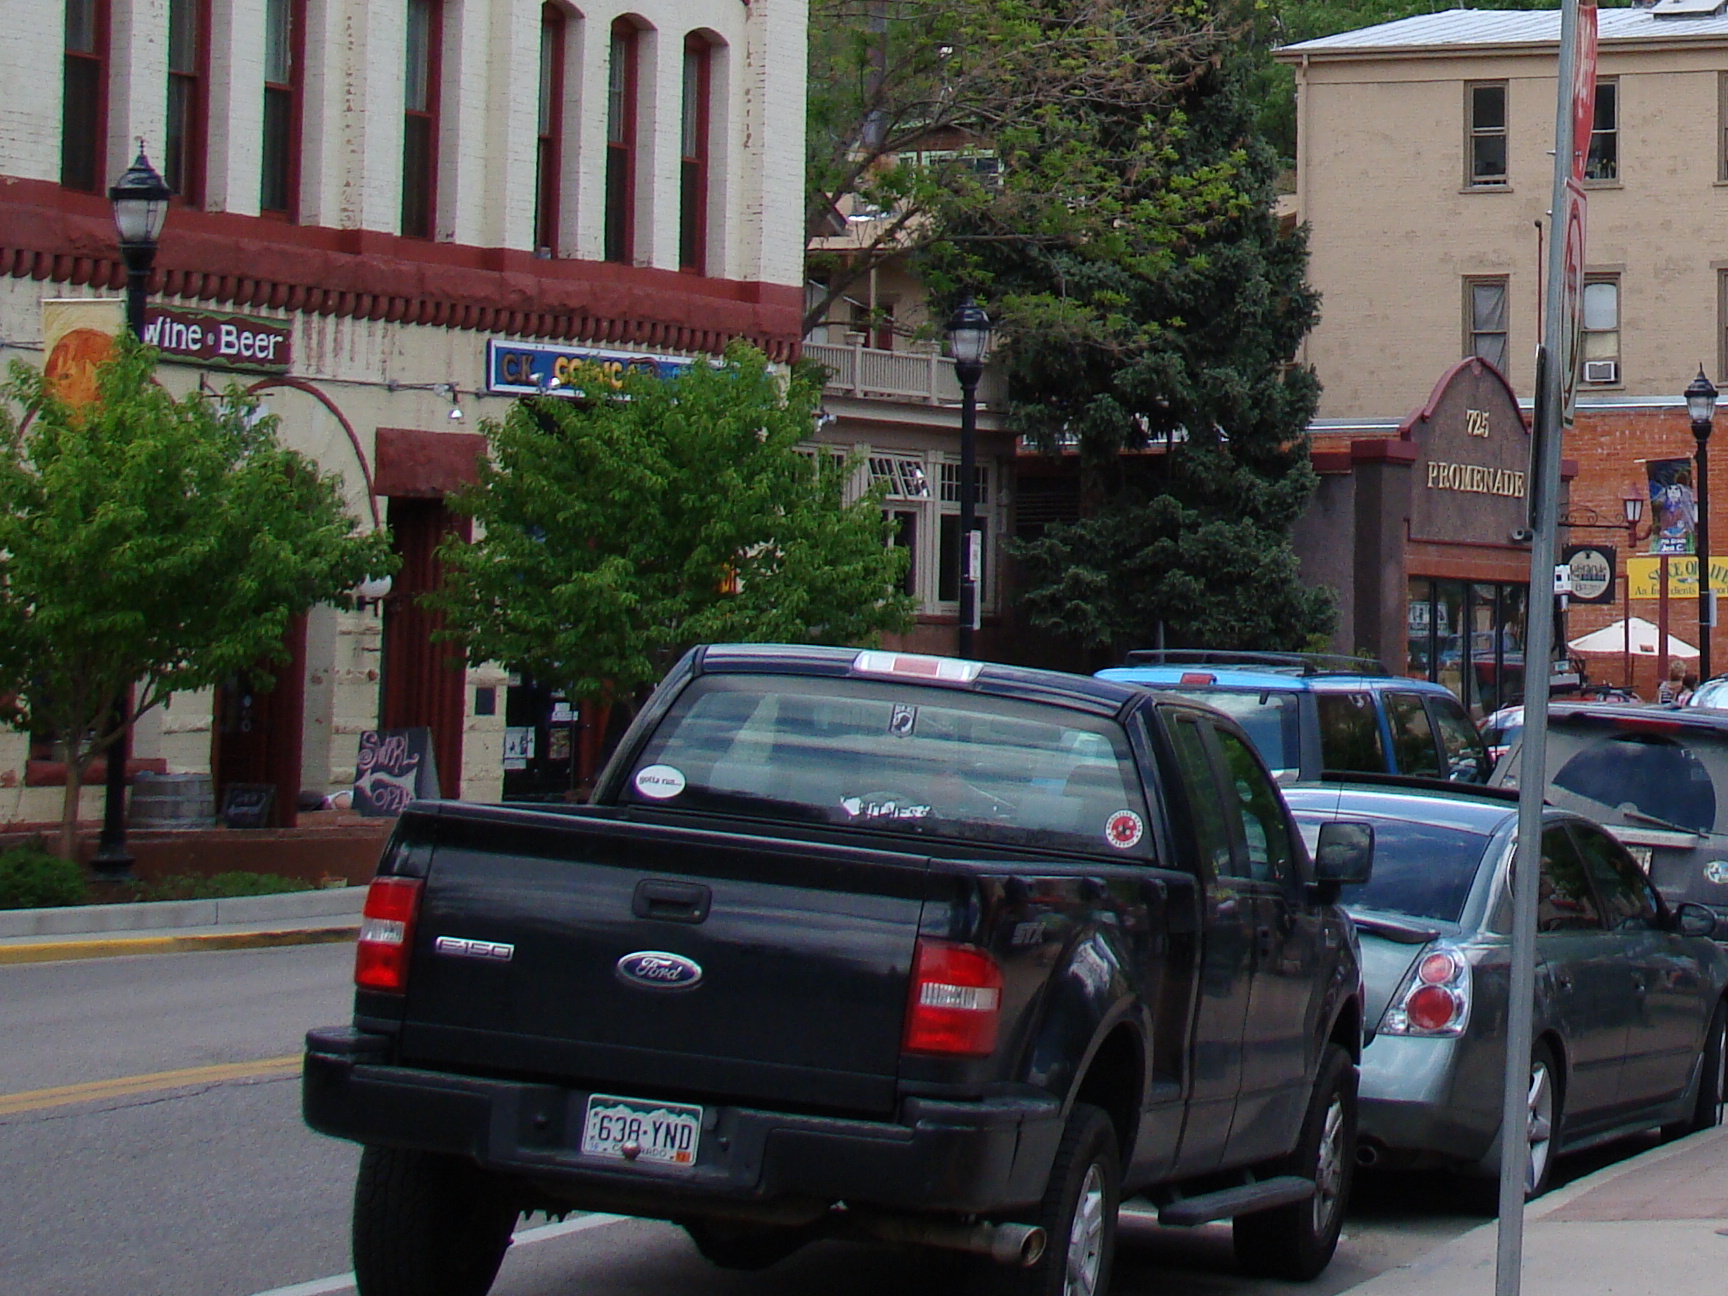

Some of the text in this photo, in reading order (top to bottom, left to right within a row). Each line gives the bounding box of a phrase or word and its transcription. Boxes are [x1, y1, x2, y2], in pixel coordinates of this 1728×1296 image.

[145, 316, 284, 360] Wine Beer
[1466, 409, 1490, 438] 725
[1427, 461, 1525, 498] PROMENADE
[1648, 562, 1683, 584] SCE
[635, 956, 682, 981] Ford
